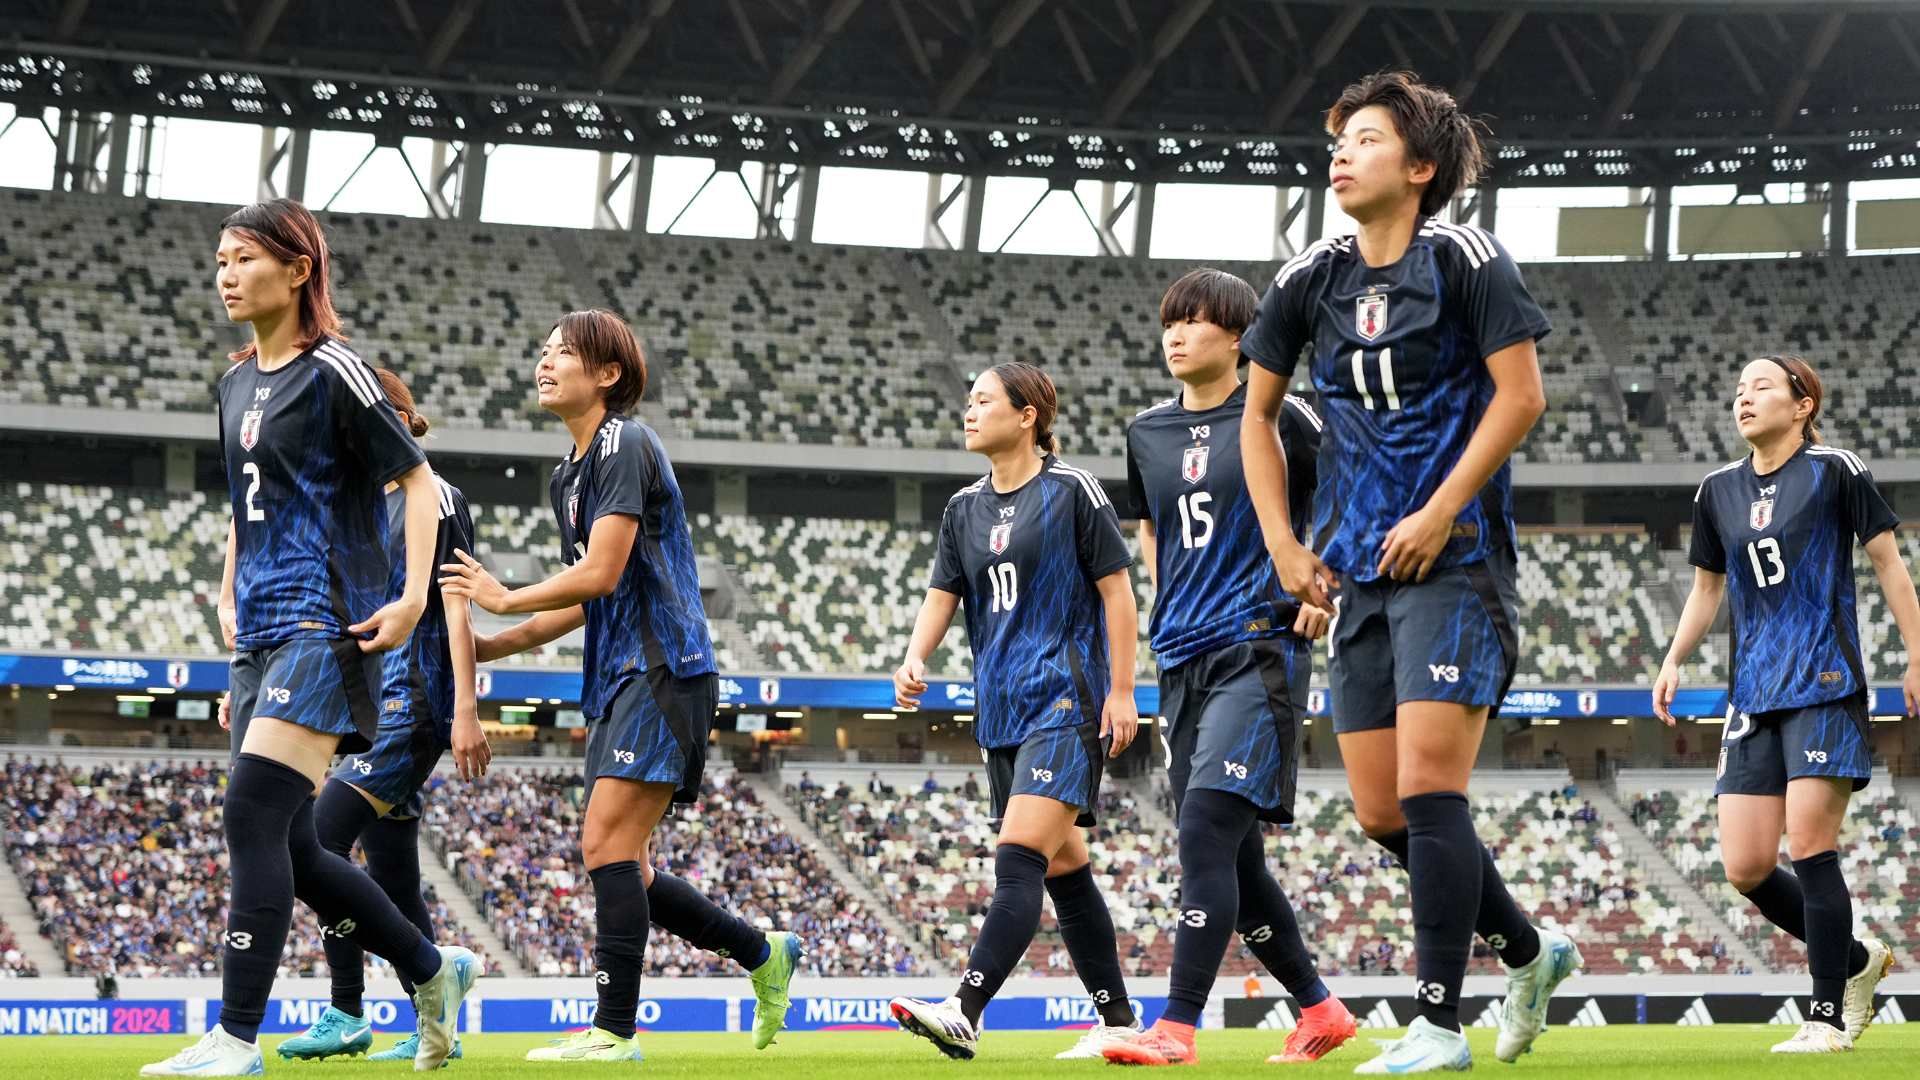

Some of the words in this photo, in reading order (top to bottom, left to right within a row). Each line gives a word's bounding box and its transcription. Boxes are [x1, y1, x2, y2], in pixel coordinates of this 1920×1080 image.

[1351, 347, 1401, 410] 11
[254, 387, 271, 401] Y-3
[1189, 425, 1210, 440] Y-3
[242, 462, 265, 522] 2
[1760, 484, 1777, 497] Y-3
[998, 505, 1015, 519] Y-3
[1178, 491, 1214, 549] 15
[1747, 537, 1786, 588] 13
[987, 562, 1018, 613] 10
[1428, 664, 1459, 683] Y-3
[266, 687, 291, 704] Y-3
[613, 749, 635, 764] Y-3
[1804, 750, 1827, 764] Y-3
[352, 757, 373, 776] Y-3
[1031, 767, 1053, 783] Y-3
[1223, 760, 1248, 780] Y-3
[805, 998, 899, 1023] MIZUH
[26, 1007, 108, 1034] MATCH
[112, 1008, 170, 1033] 2024
